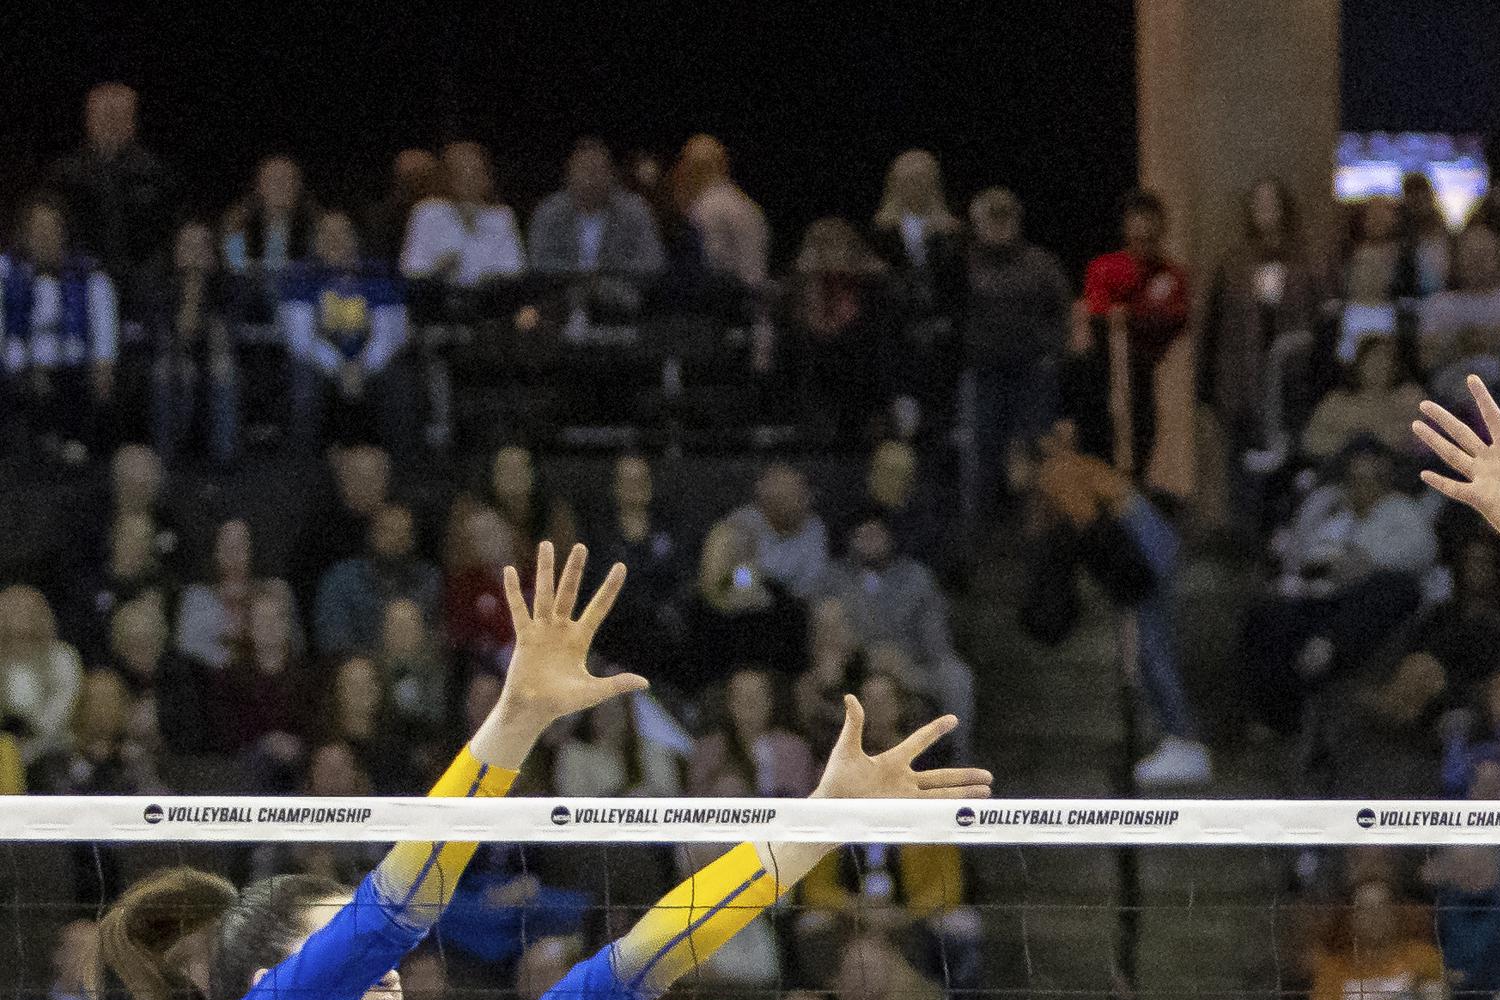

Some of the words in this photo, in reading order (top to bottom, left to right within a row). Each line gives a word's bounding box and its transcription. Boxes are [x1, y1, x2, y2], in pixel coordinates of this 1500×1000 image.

[169, 807, 252, 822] VOLLEYBALL
[258, 807, 371, 822] CHAMPIONSHIP
[576, 808, 657, 823] VOLLEYBALL
[663, 808, 776, 823] CHAMPIONSHIP
[980, 810, 1062, 825] VOLLEYBALL
[1068, 810, 1178, 825] CHAMPIONSHIP
[1380, 811, 1461, 826] VOLLEYBALL
